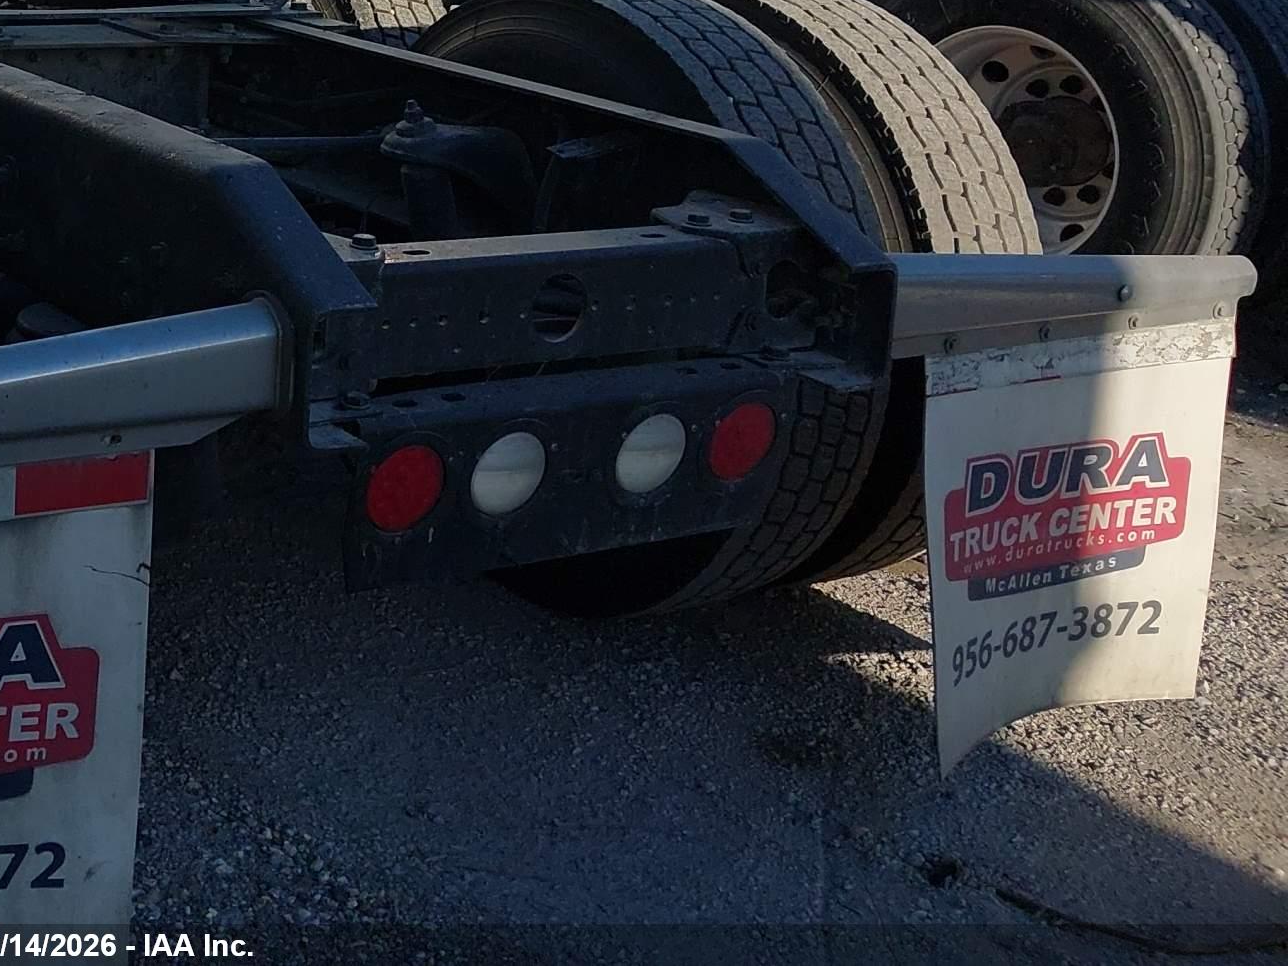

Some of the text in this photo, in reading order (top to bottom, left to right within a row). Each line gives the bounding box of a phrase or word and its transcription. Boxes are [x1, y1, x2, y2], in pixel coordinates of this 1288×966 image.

[965, 436, 1170, 517] DURA
[950, 496, 1177, 563] TRUCK CENTER
[963, 527, 1155, 575] www.duratrucks.com
[985, 556, 1117, 594] McAllen Texas
[952, 599, 1162, 687] 956-687-3872
